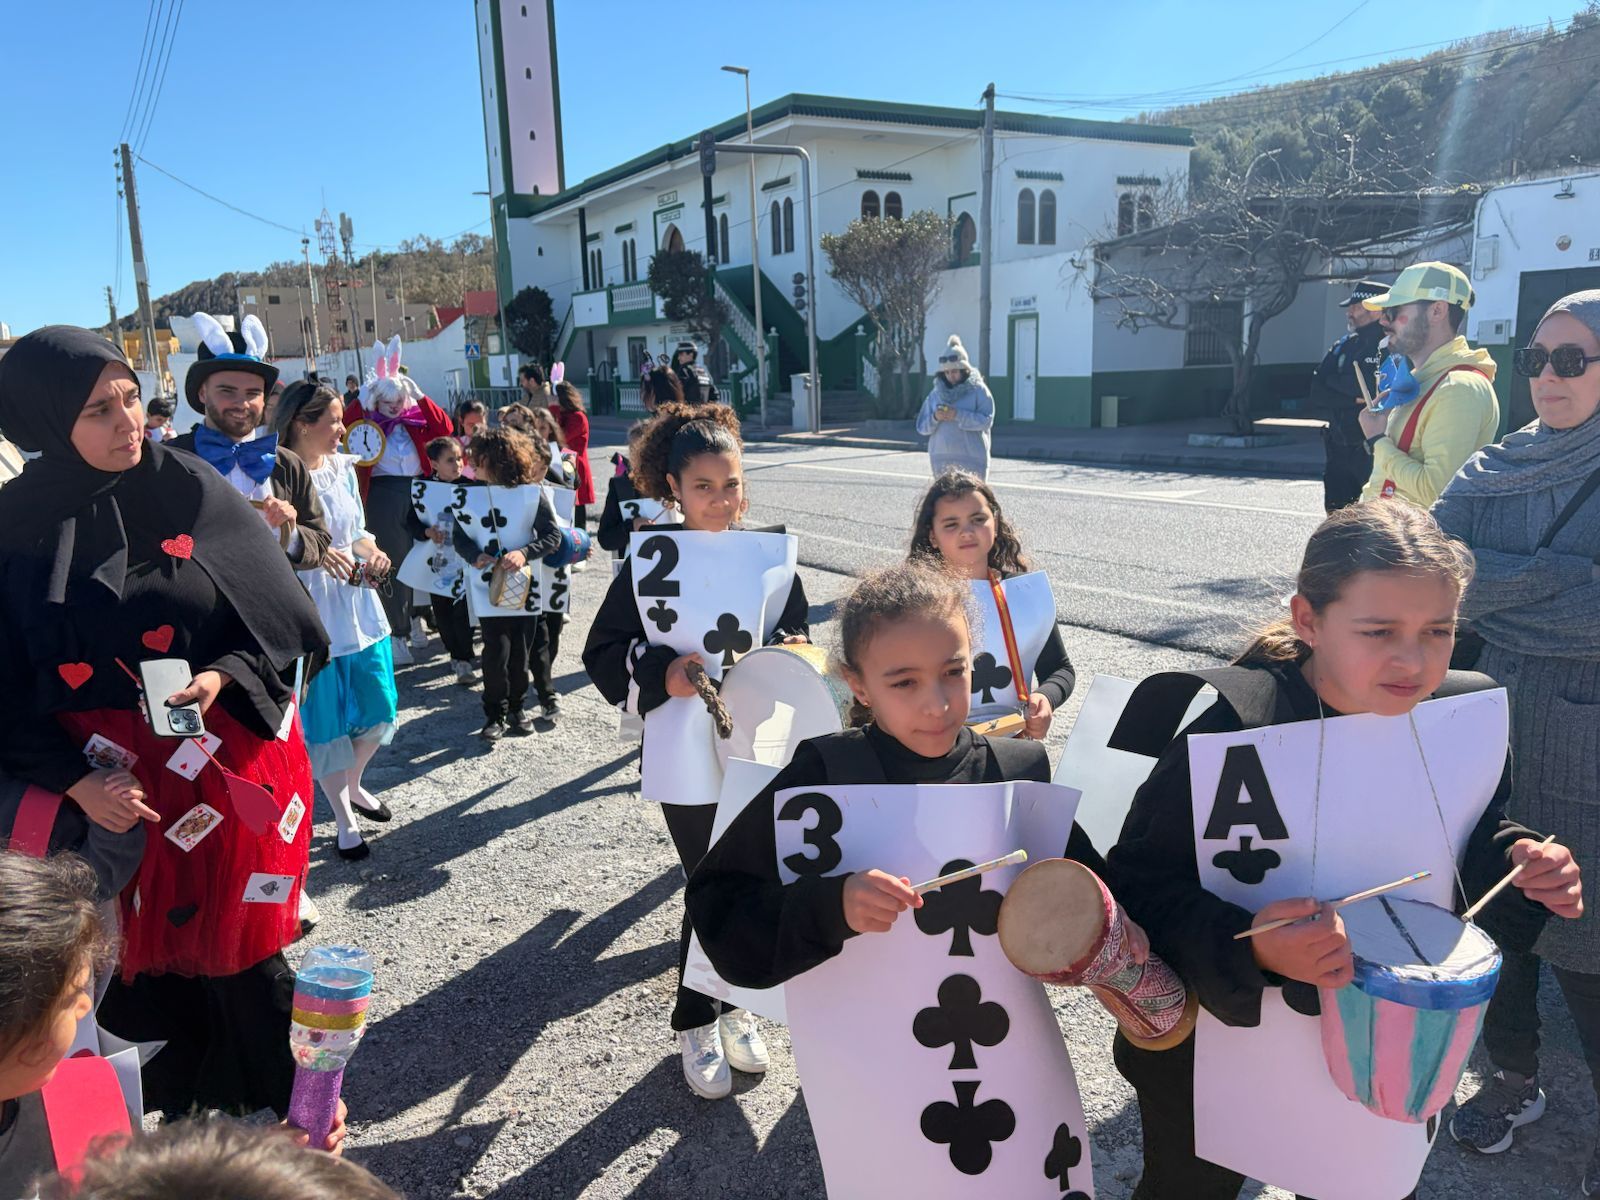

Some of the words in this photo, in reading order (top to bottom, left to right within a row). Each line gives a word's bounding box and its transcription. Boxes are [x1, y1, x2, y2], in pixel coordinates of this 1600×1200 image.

[412, 481, 427, 500] 3
[452, 487, 468, 509] 3
[637, 534, 680, 597] 2
[549, 582, 567, 611] 2
[1203, 744, 1290, 841] A
[777, 793, 844, 877] 3
